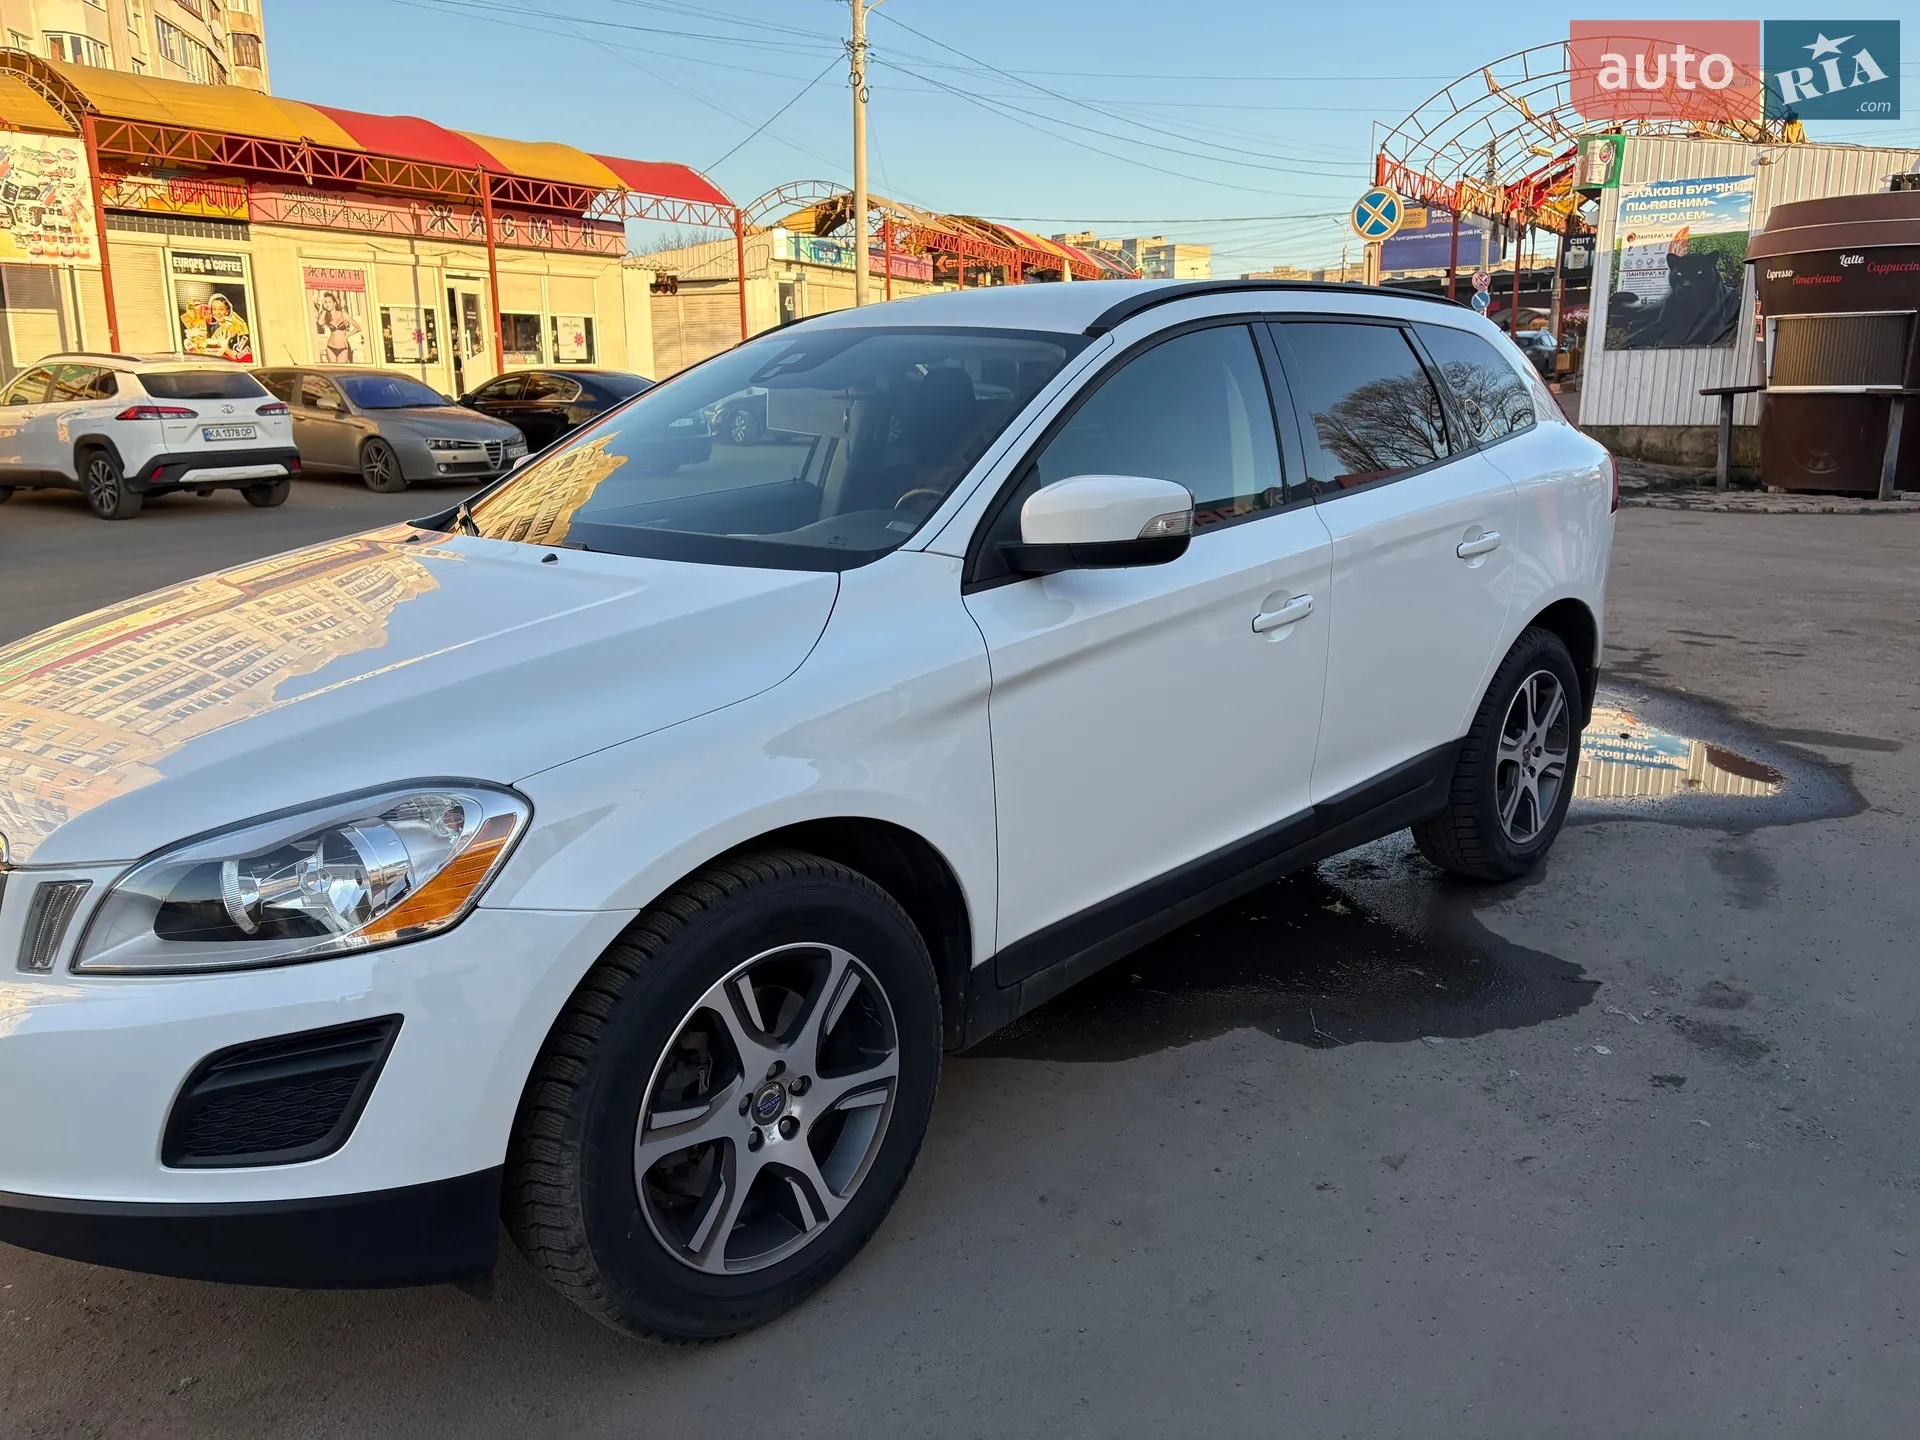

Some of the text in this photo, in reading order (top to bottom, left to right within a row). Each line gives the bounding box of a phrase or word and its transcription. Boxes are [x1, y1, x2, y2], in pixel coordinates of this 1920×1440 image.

[283, 188, 347, 206] ЖІНОЧА ТА
[1627, 183, 1744, 198] ЗЛАКОВІ БУР'ЯНИ
[1626, 198, 1708, 212] ПІД ПОВНИМ
[284, 204, 386, 225] ЧОЛОВІЧА БІЛИЗНА
[1625, 211, 1706, 224] КОНТРОЛЕМ
[426, 204, 598, 248] ЖАСМІН
[1569, 237, 1590, 245] СВІТ
[172, 256, 242, 272] EUROPE & COFFEE
[1839, 254, 1865, 267] Latte
[308, 267, 361, 280] ЖАСМІН
[1866, 261, 1920, 275] Cappuccin
[1792, 274, 1842, 287] Americano
[210, 428, 252, 438] KA 1378 OP
[759, 1096, 781, 1111] VOLVO
